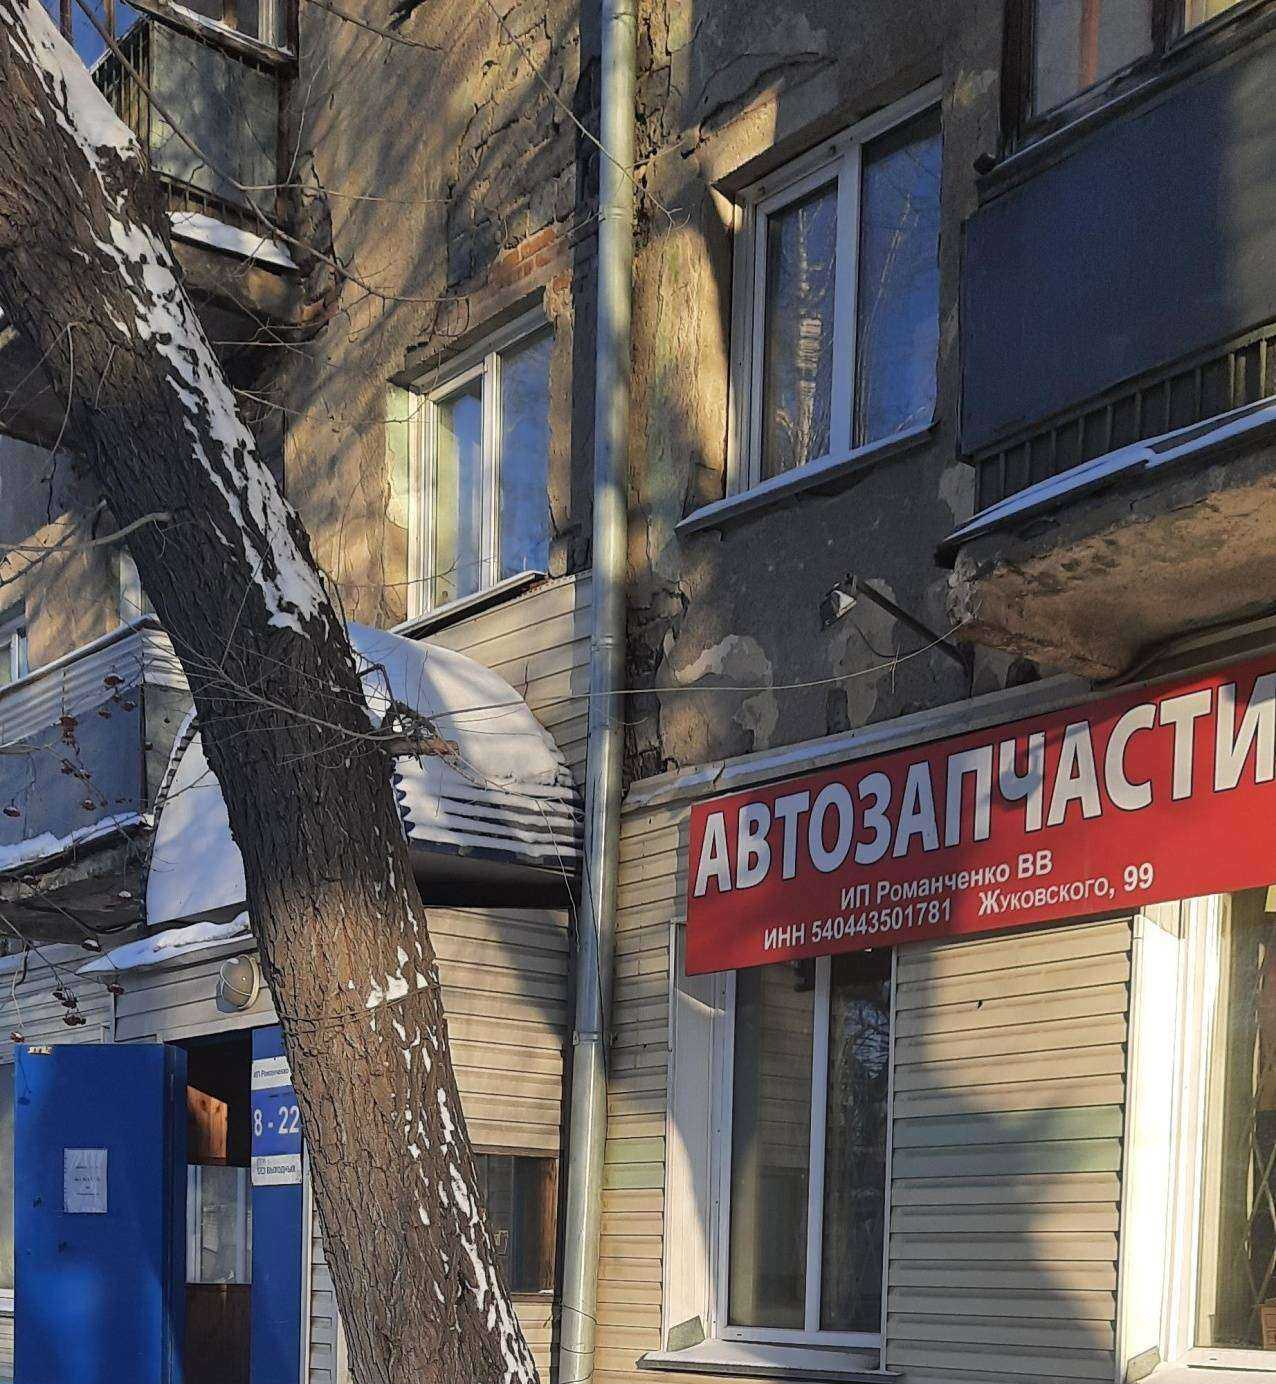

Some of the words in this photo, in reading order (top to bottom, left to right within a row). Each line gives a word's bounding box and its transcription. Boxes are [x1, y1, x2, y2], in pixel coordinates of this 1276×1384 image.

[693, 673, 1276, 897] АВТОЗАПЧАСТИ
[840, 884, 870, 911] ИП
[876, 863, 1010, 904] Романченко
[1017, 849, 1053, 880] ВВ
[1123, 862, 1154, 892] 99
[764, 922, 805, 951] ИНН
[811, 899, 951, 942] 540443501781
[253, 1108, 263, 1137] 8
[278, 1105, 300, 1135] 22
